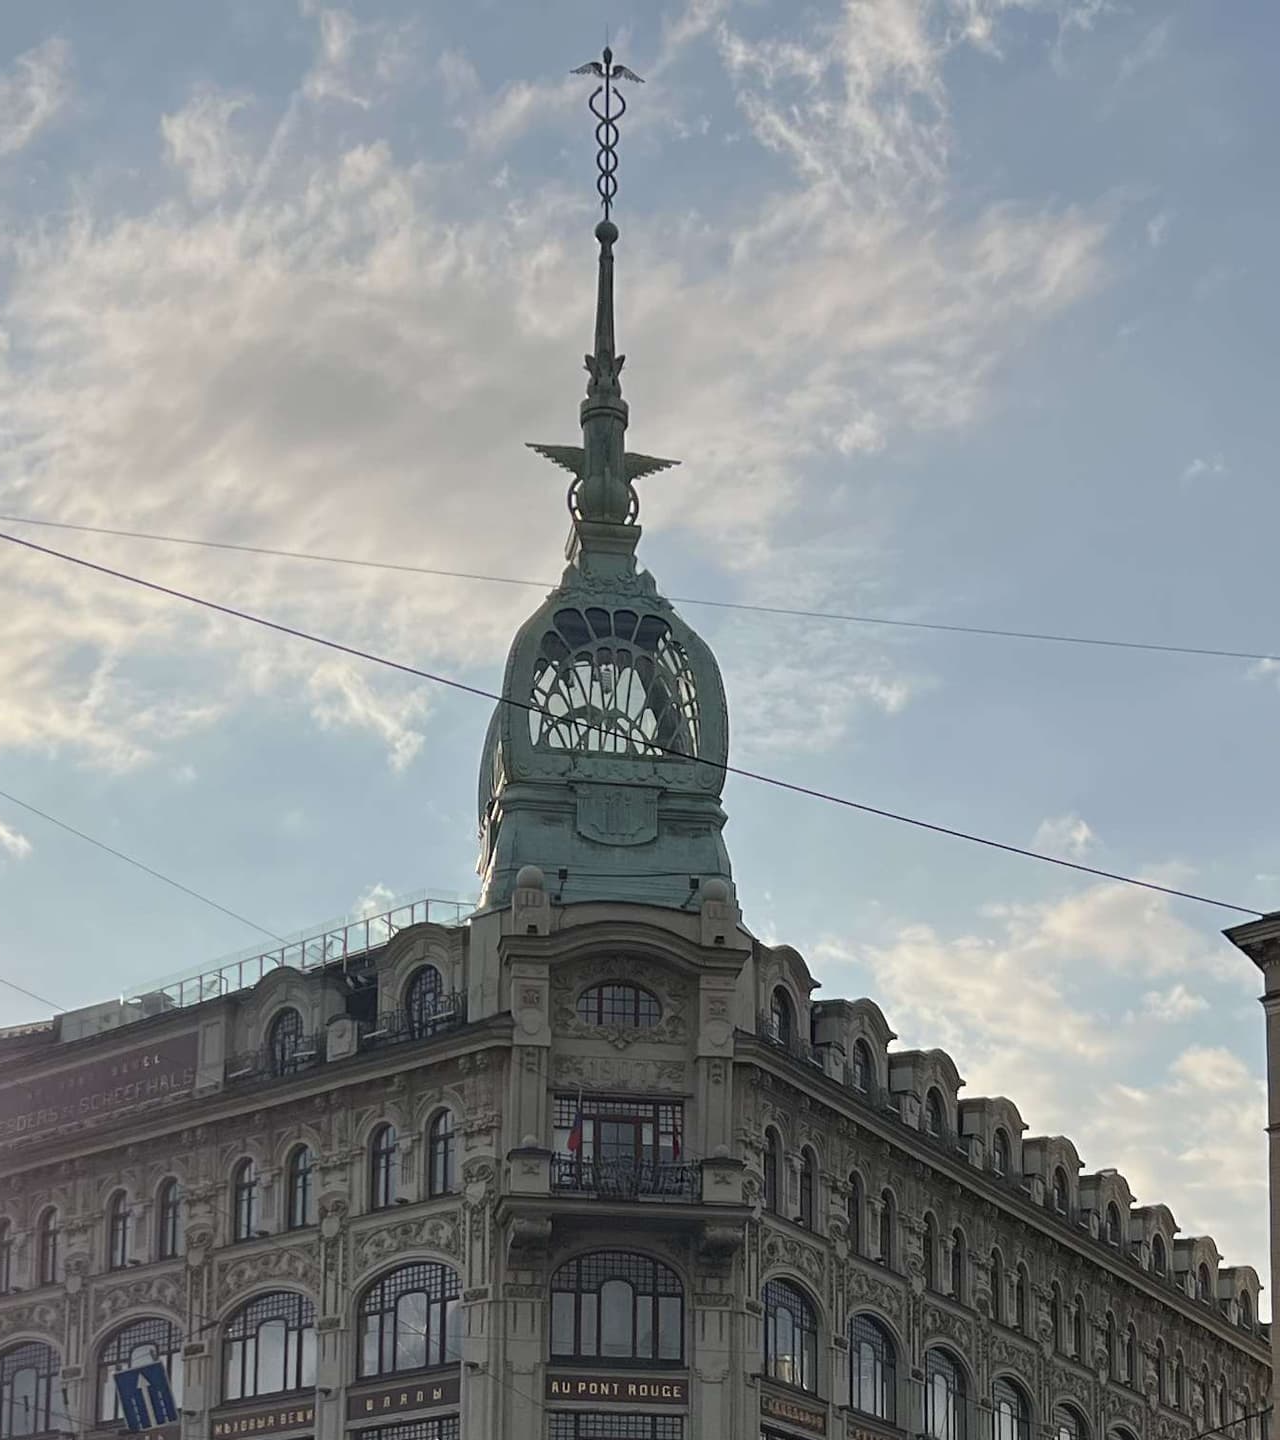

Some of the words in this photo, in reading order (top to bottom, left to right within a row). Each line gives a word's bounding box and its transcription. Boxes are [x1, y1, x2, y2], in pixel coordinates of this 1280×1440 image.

[551, 1381, 571, 1395] AU
[577, 1382, 620, 1397] PONT
[627, 1384, 682, 1399] ROUGE
